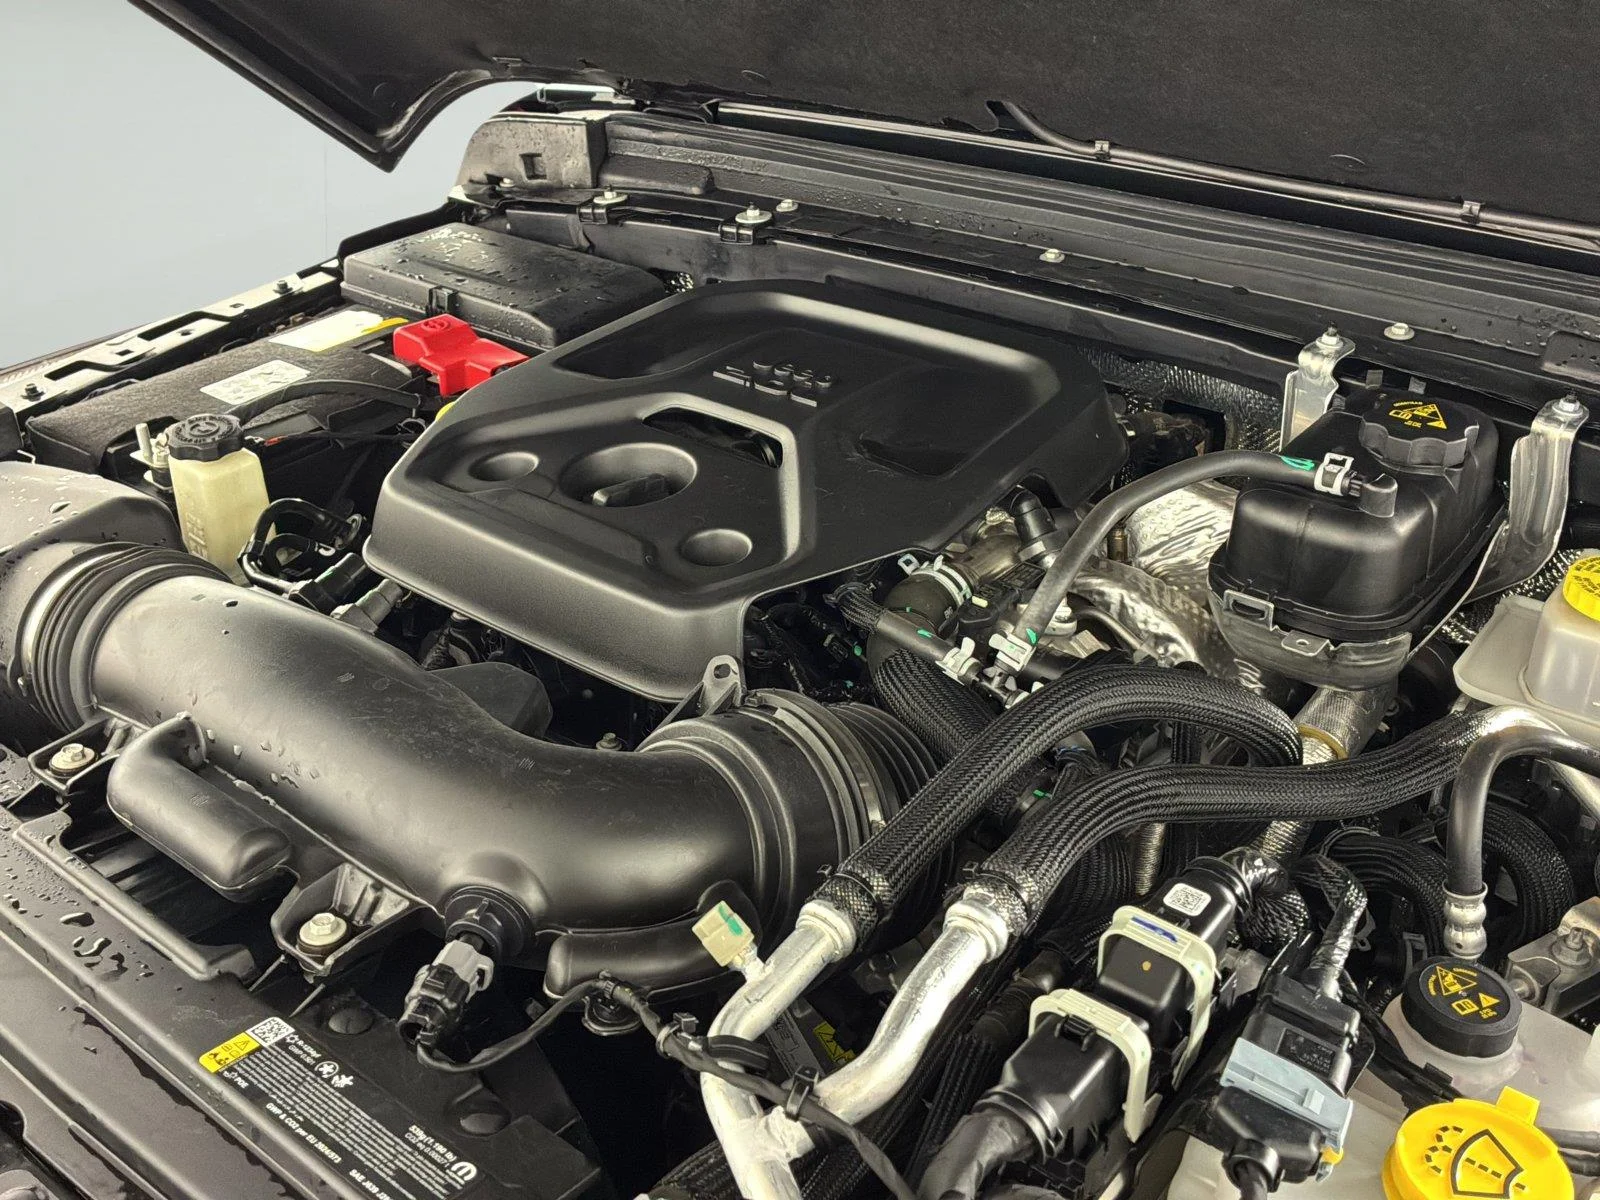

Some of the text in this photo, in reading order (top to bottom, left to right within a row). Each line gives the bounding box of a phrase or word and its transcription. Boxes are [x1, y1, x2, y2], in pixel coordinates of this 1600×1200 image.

[233, 1076, 250, 1089] POE
[265, 1102, 283, 1115] GWP
[284, 1117, 300, 1130] CO2
[294, 1127, 309, 1138] per
[305, 1134, 319, 1144] EU
[349, 1169, 366, 1183] SAE
[361, 1180, 380, 1194] J639
